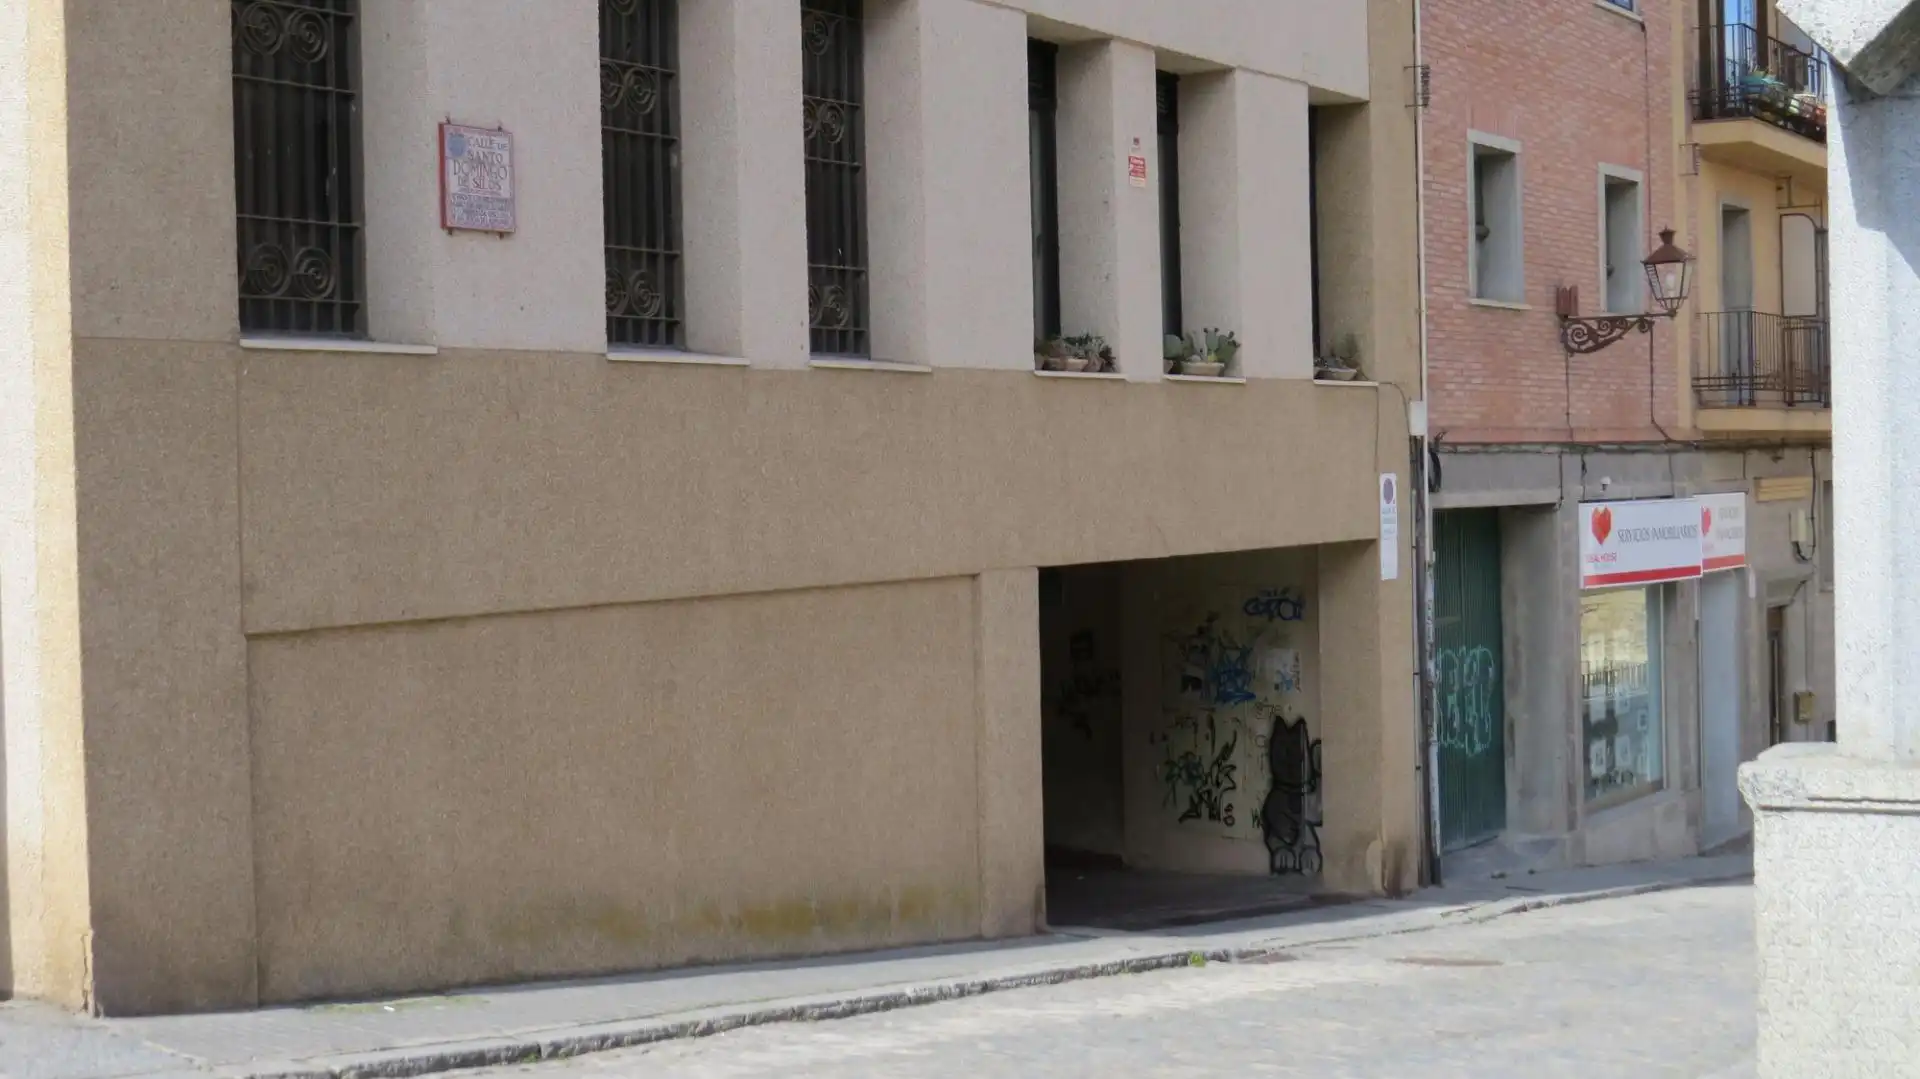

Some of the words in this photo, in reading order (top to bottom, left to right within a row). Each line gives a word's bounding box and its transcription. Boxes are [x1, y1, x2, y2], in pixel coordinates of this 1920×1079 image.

[468, 136, 493, 149] CALLE
[467, 150, 503, 165] SANTO
[453, 159, 508, 180] DOMINGO
[457, 175, 469, 187] DE
[471, 176, 502, 190] SILOS
